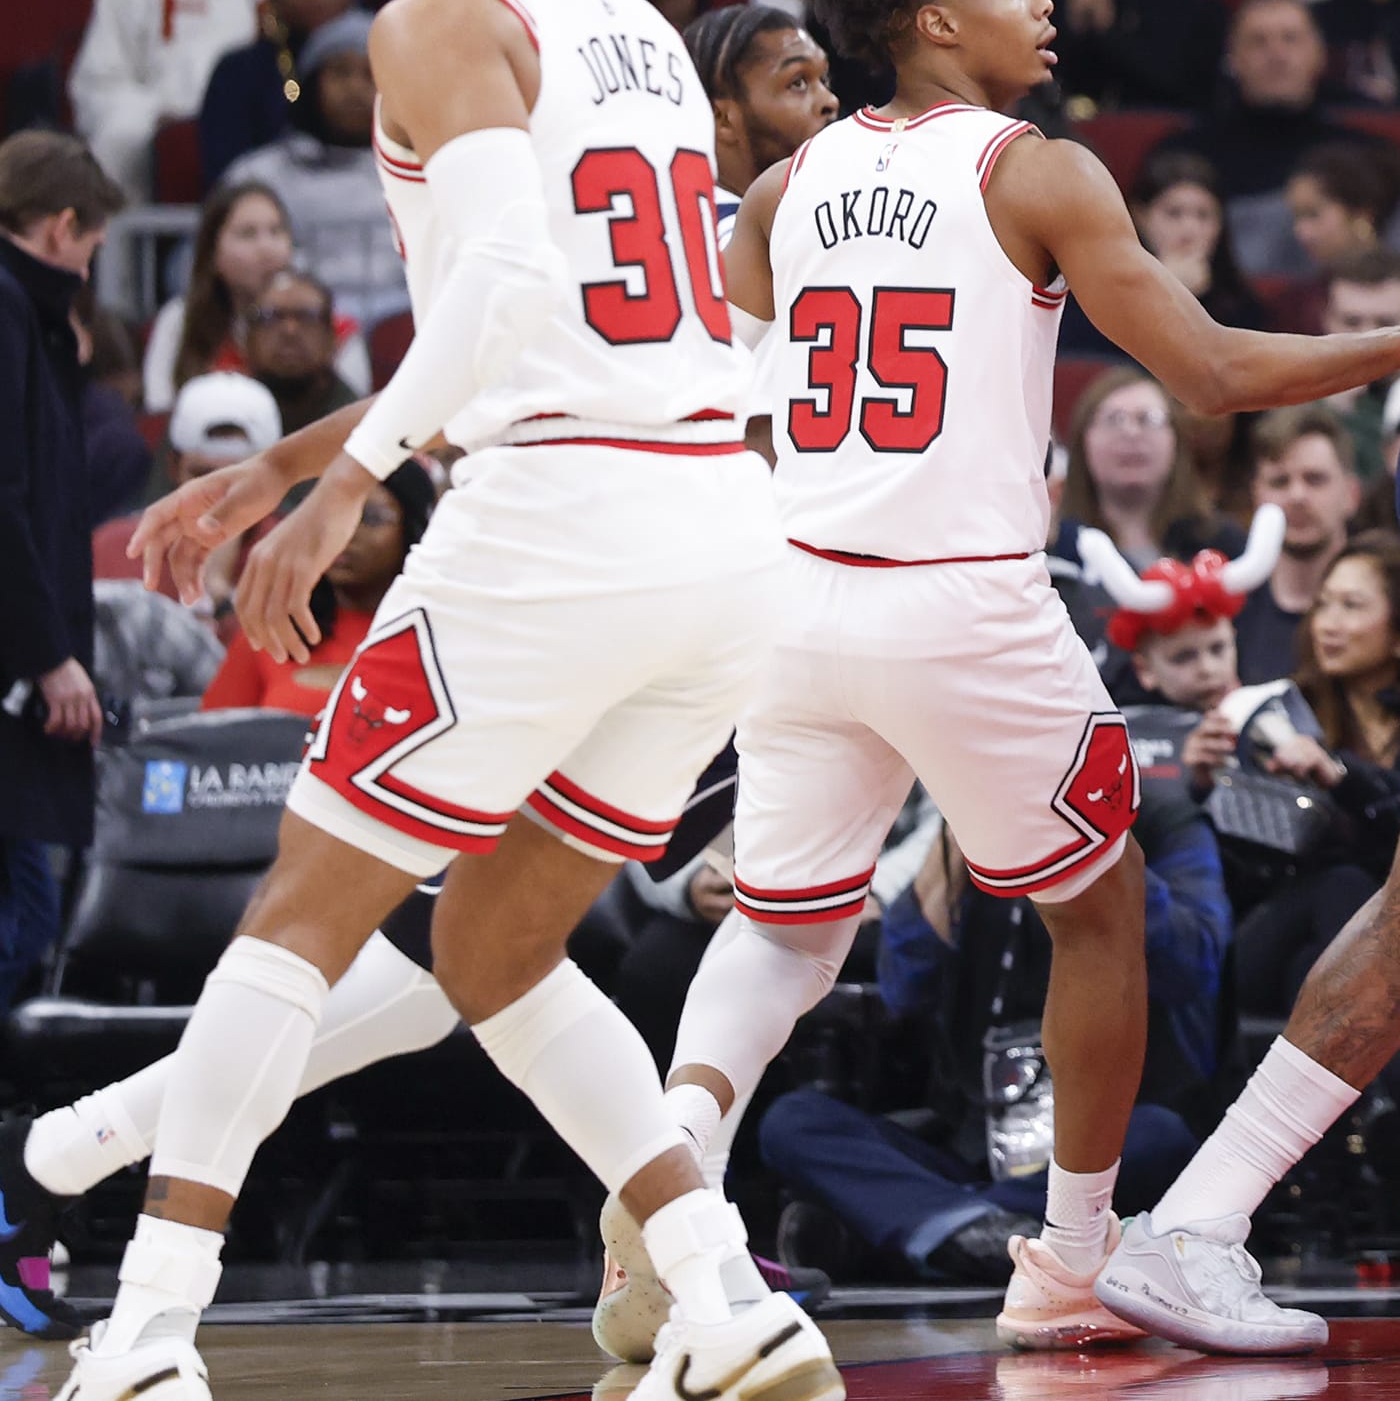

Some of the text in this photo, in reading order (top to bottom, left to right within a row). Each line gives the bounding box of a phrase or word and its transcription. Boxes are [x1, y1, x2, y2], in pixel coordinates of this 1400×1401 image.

[577, 34, 683, 106] JONES
[571, 146, 732, 347] 30
[814, 187, 938, 250] OKORO
[787, 286, 956, 454] 35
